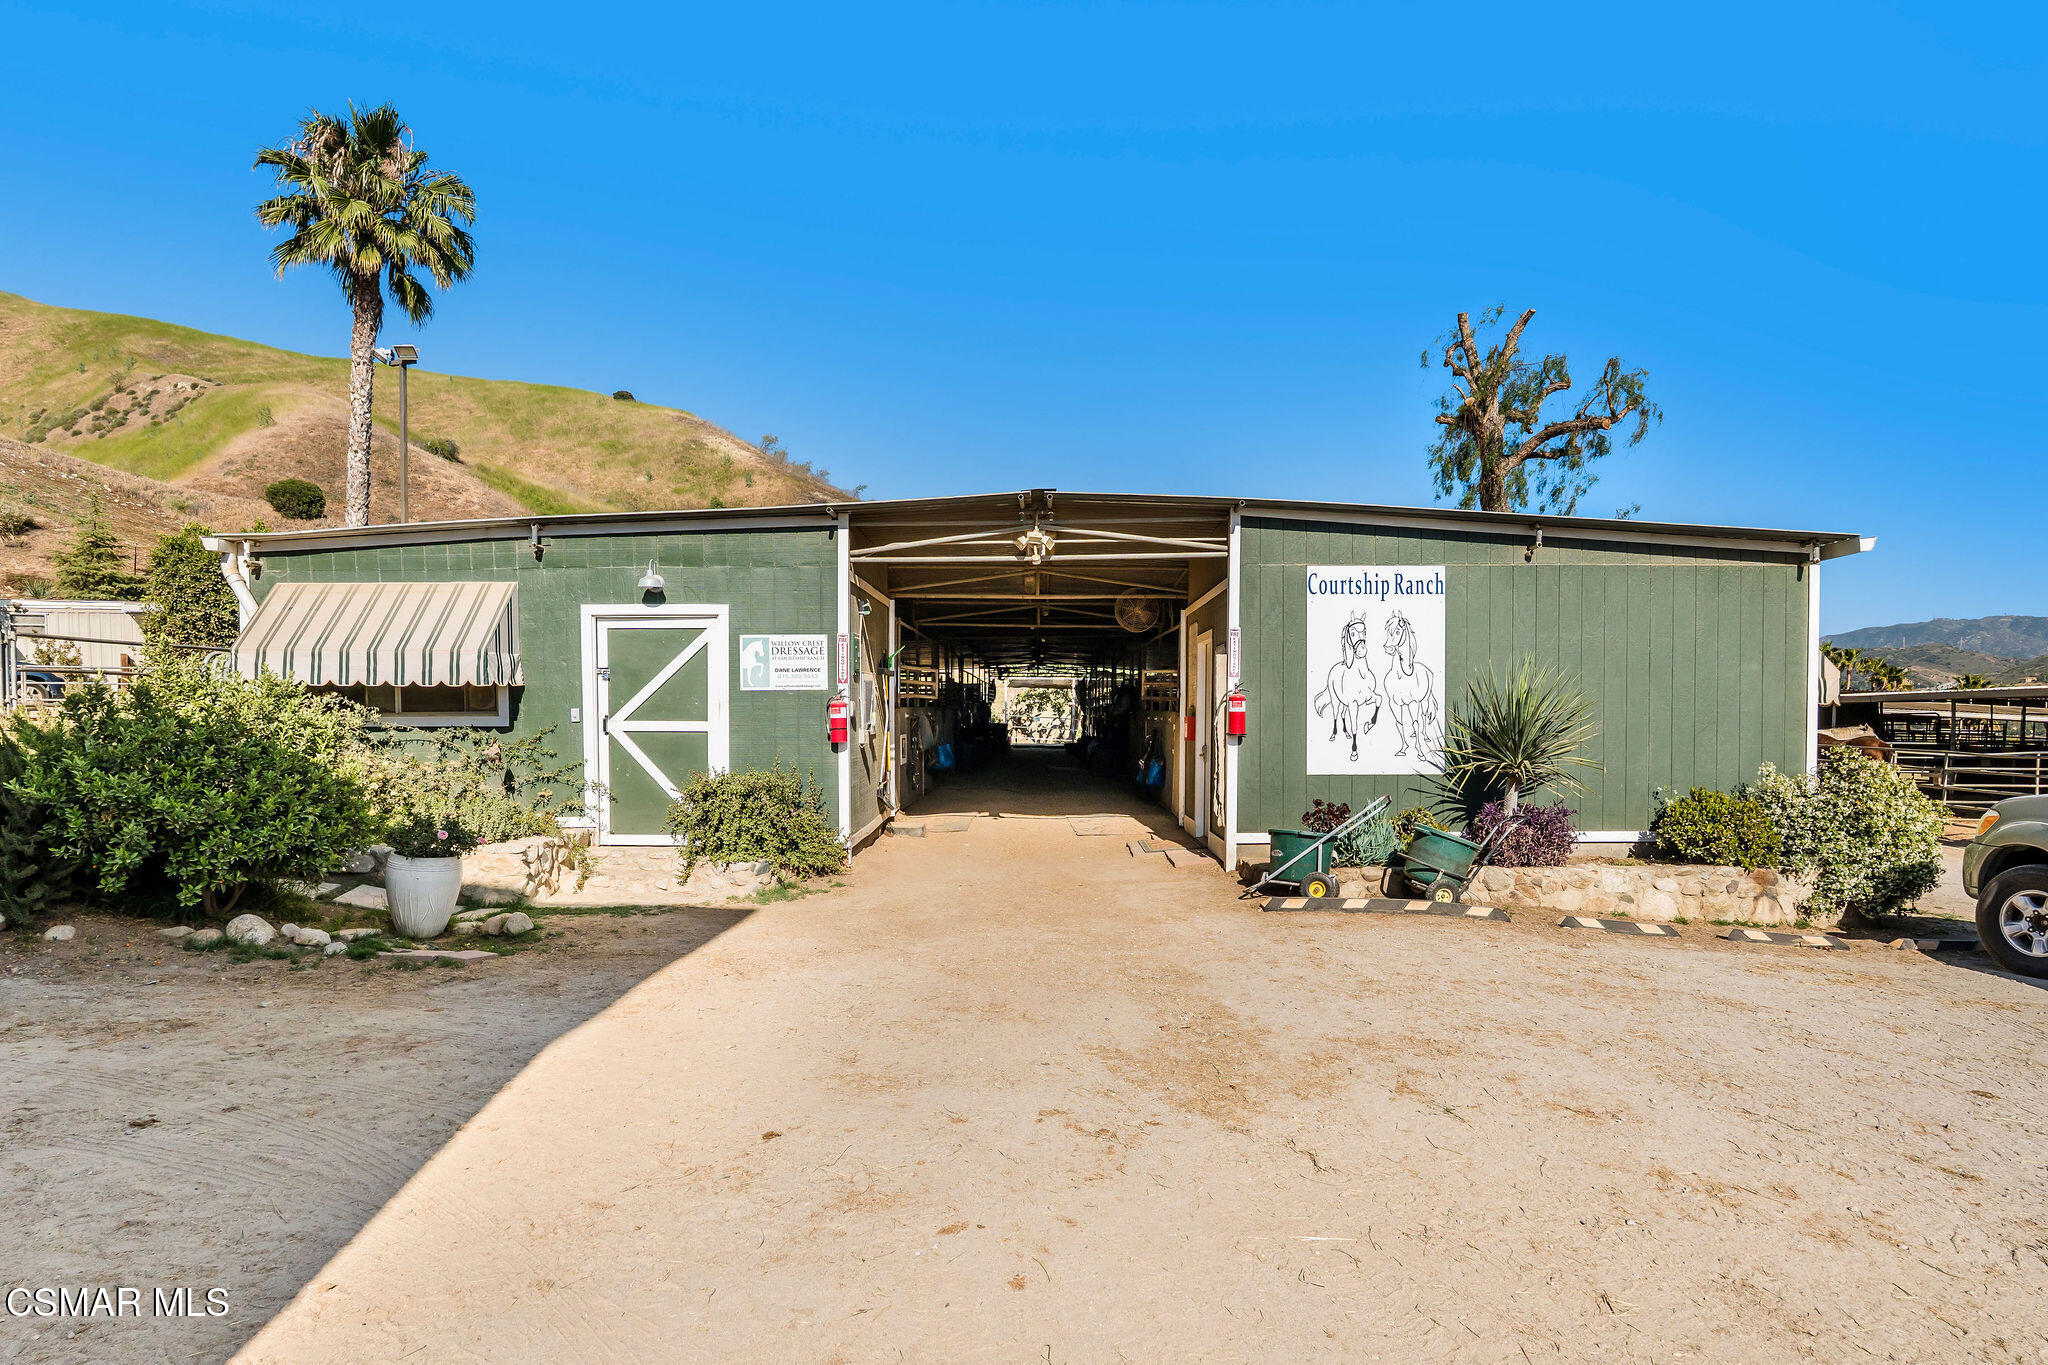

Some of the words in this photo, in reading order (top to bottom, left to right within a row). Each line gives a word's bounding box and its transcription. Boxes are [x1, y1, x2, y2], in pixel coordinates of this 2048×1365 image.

[1307, 572, 1390, 602] Courtship
[1394, 572, 1445, 595] Ranch
[771, 647, 825, 655] DRESSAGE
